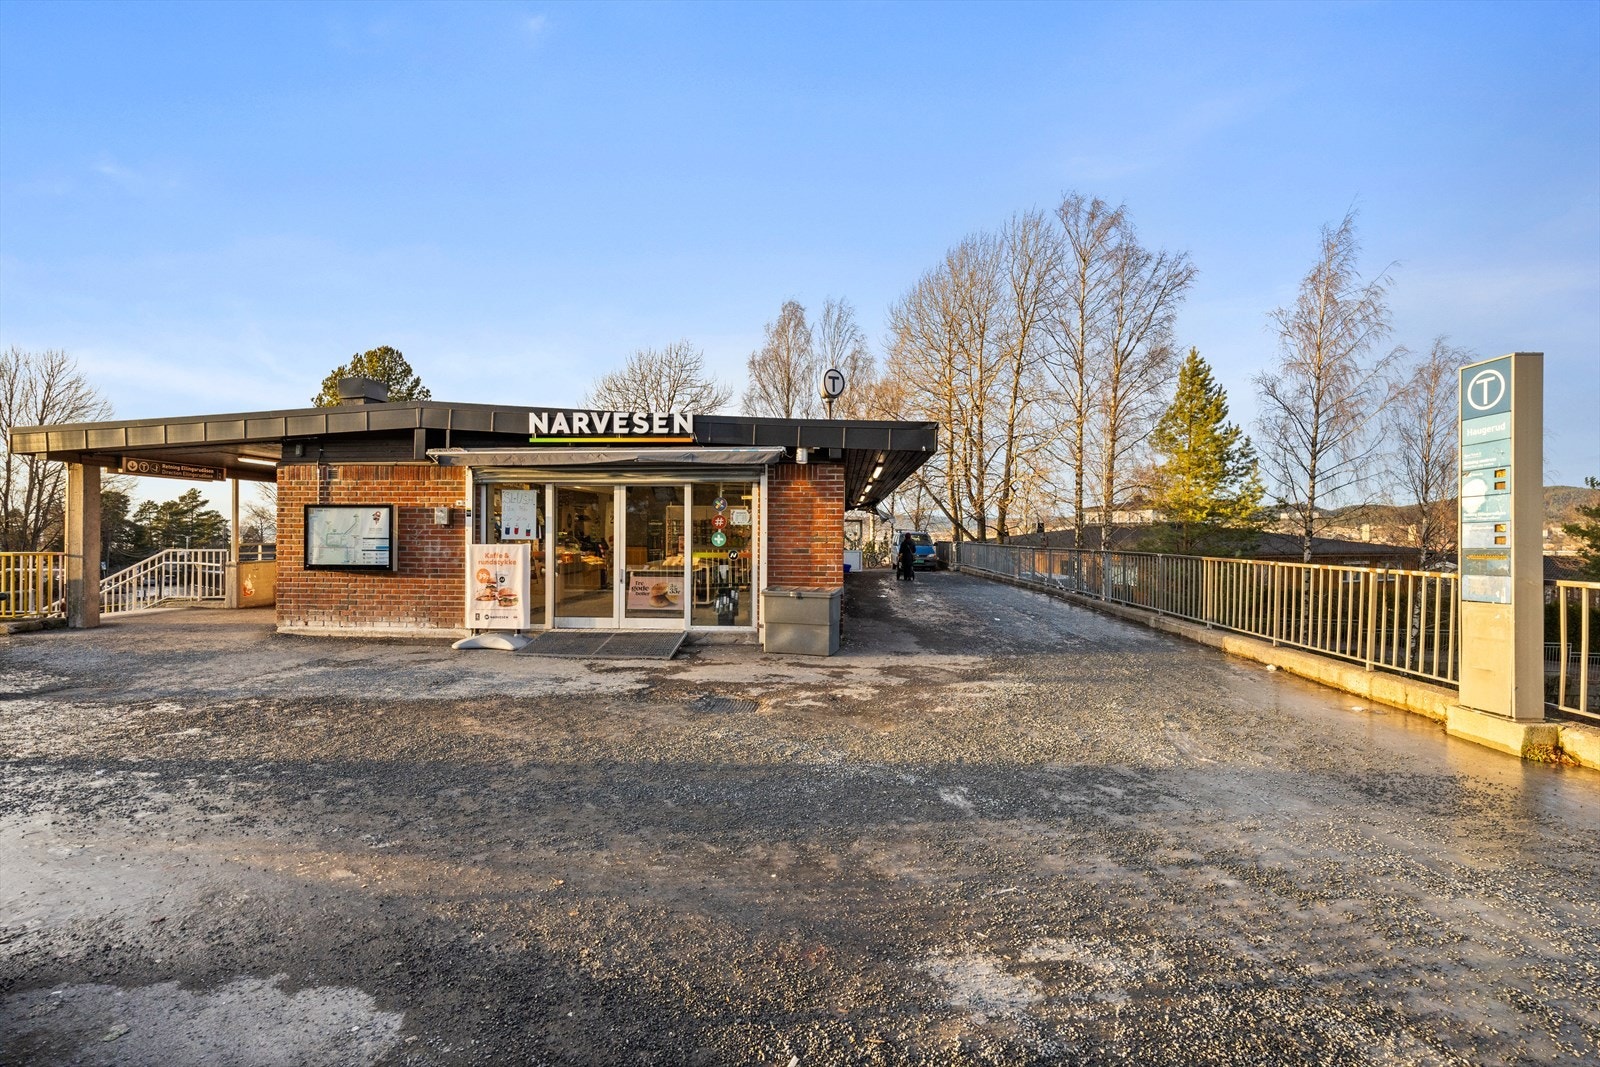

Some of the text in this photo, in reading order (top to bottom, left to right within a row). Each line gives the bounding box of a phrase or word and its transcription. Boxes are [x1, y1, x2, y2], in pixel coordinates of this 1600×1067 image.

[828, 376, 839, 392] T
[1476, 376, 1495, 405] T
[528, 412, 694, 434] NARVESEN
[1466, 421, 1506, 437] Haugerud
[161, 463, 180, 471] Retning
